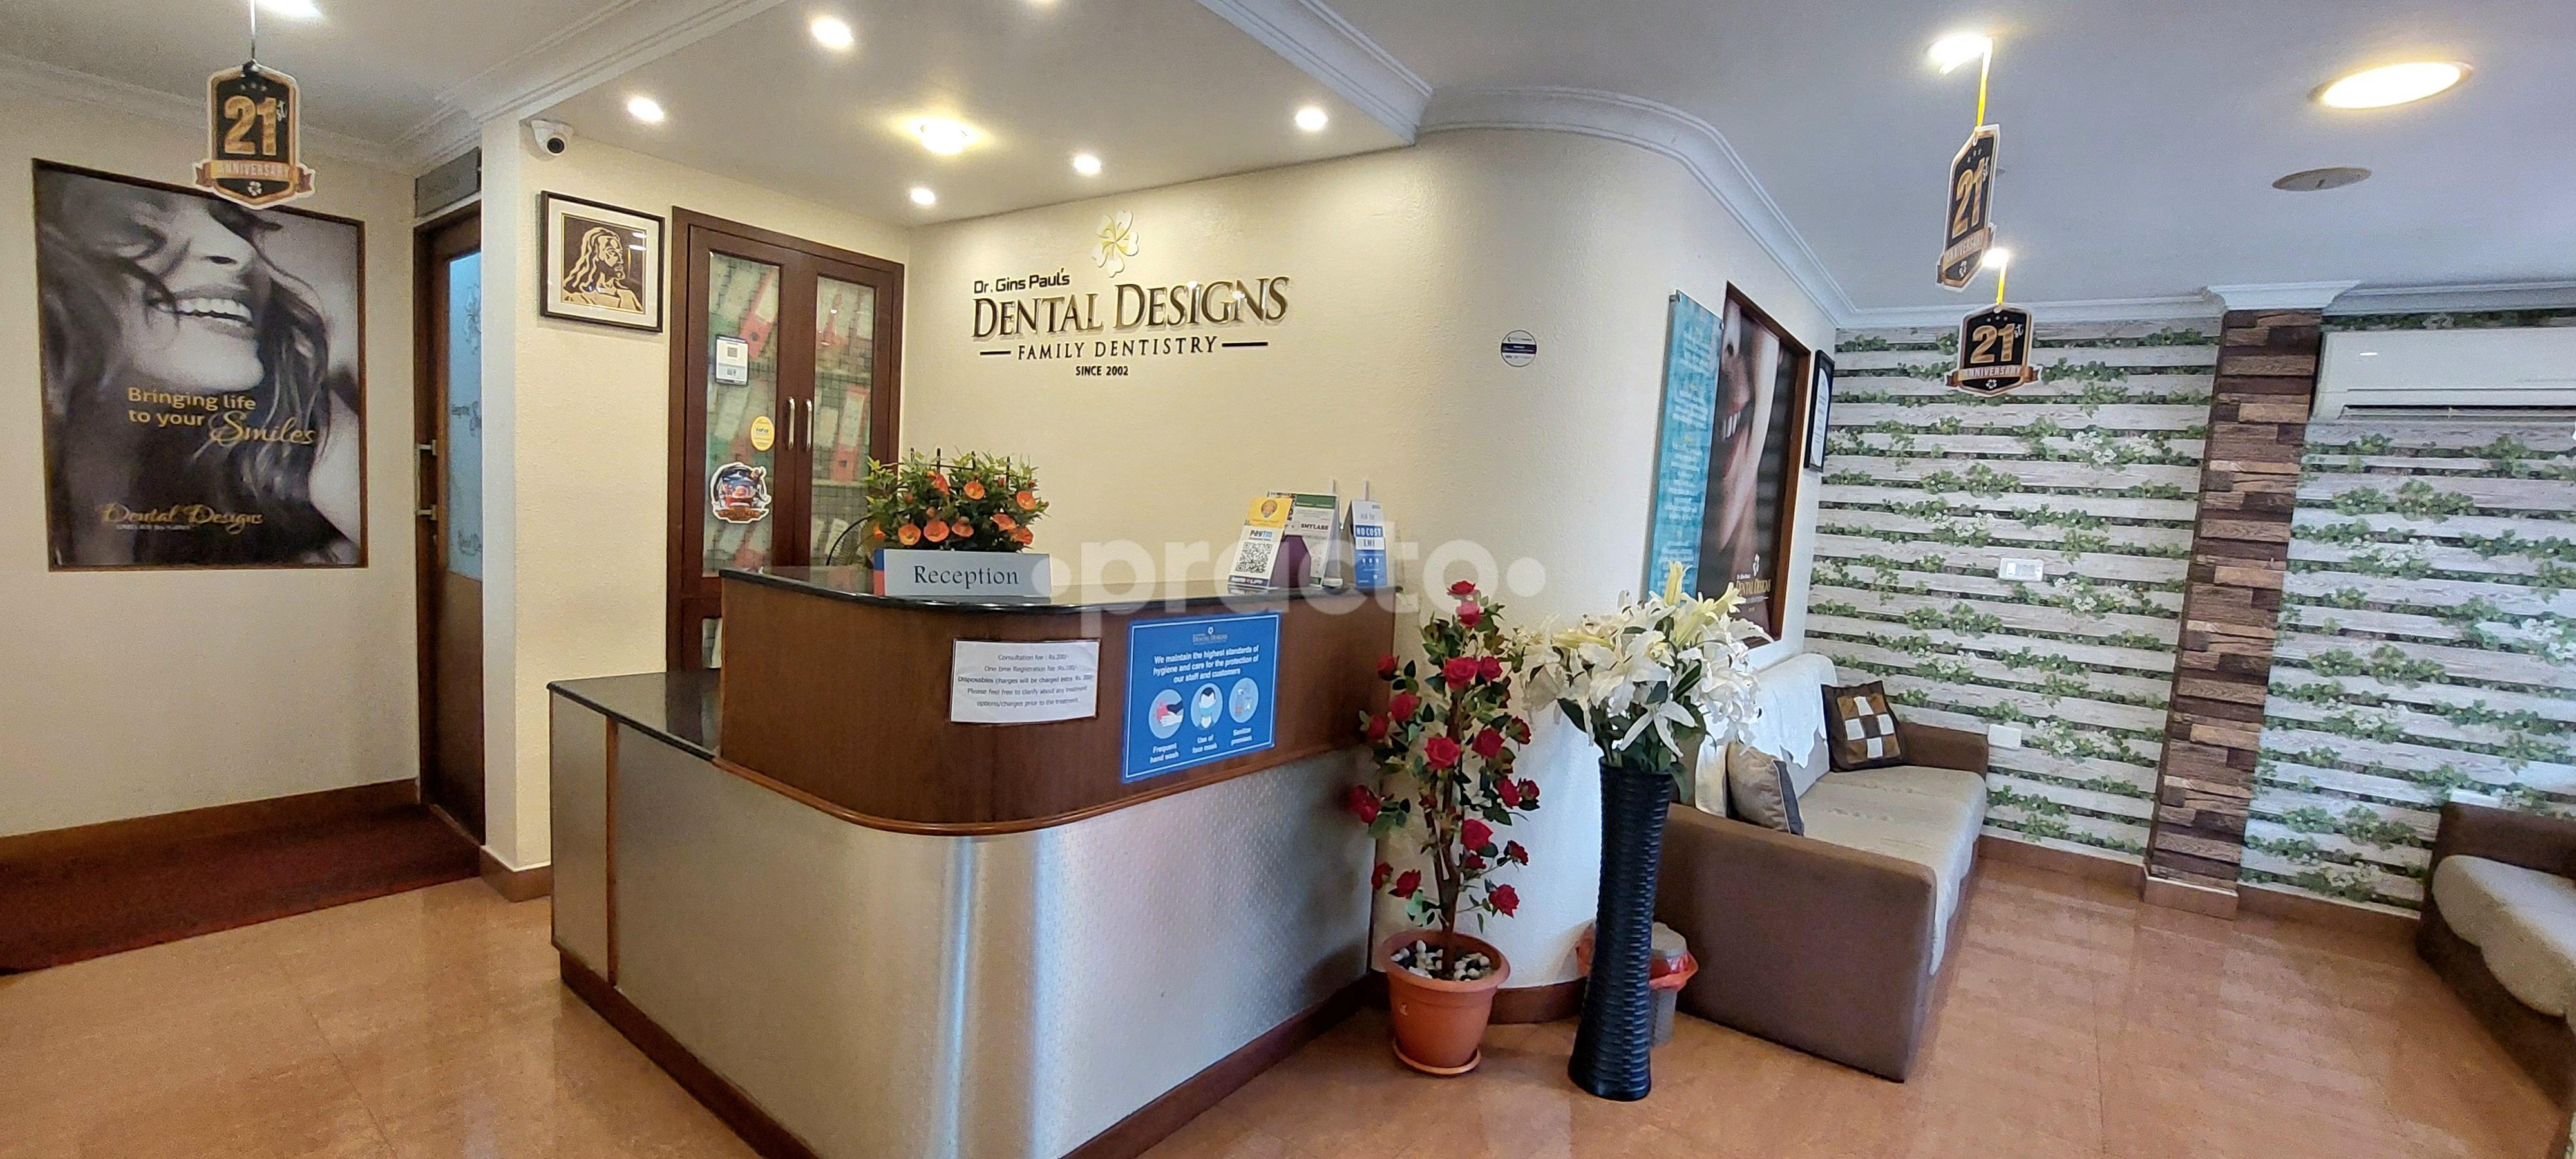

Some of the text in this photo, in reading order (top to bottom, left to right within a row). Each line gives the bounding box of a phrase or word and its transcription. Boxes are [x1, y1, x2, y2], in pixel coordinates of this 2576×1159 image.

[974, 267, 1070, 294] Dr. Gins Paul's
[971, 276, 1289, 337] DENTAL DESIGNS
[1018, 335, 1218, 360] FAMILY DENTISTRY
[1075, 366, 1129, 375] SINCE 2002
[1961, 366, 2022, 377] ANNIVERSARY
[128, 386, 256, 411] Bringing life
[129, 410, 205, 427] to your
[208, 410, 318, 447] Smiles
[102, 502, 263, 534] Dental Designs
[1356, 527, 1381, 536] NO COST
[914, 565, 1019, 589] Reception
[1154, 655, 1164, 664] We
[1166, 652, 1191, 663] maintain
[1204, 648, 1225, 659] highest
[1226, 646, 1253, 656] standards
[1153, 666, 1178, 676] hygiene
[1179, 663, 1191, 672] and
[1206, 660, 1214, 668] for
[1215, 659, 1224, 667] the
[1225, 657, 1252, 668] protection
[1186, 672, 1199, 682] staff
[1212, 668, 1241, 678] customers
[1153, 742, 1177, 754] Frequent
[1150, 751, 1180, 764] hand wash
